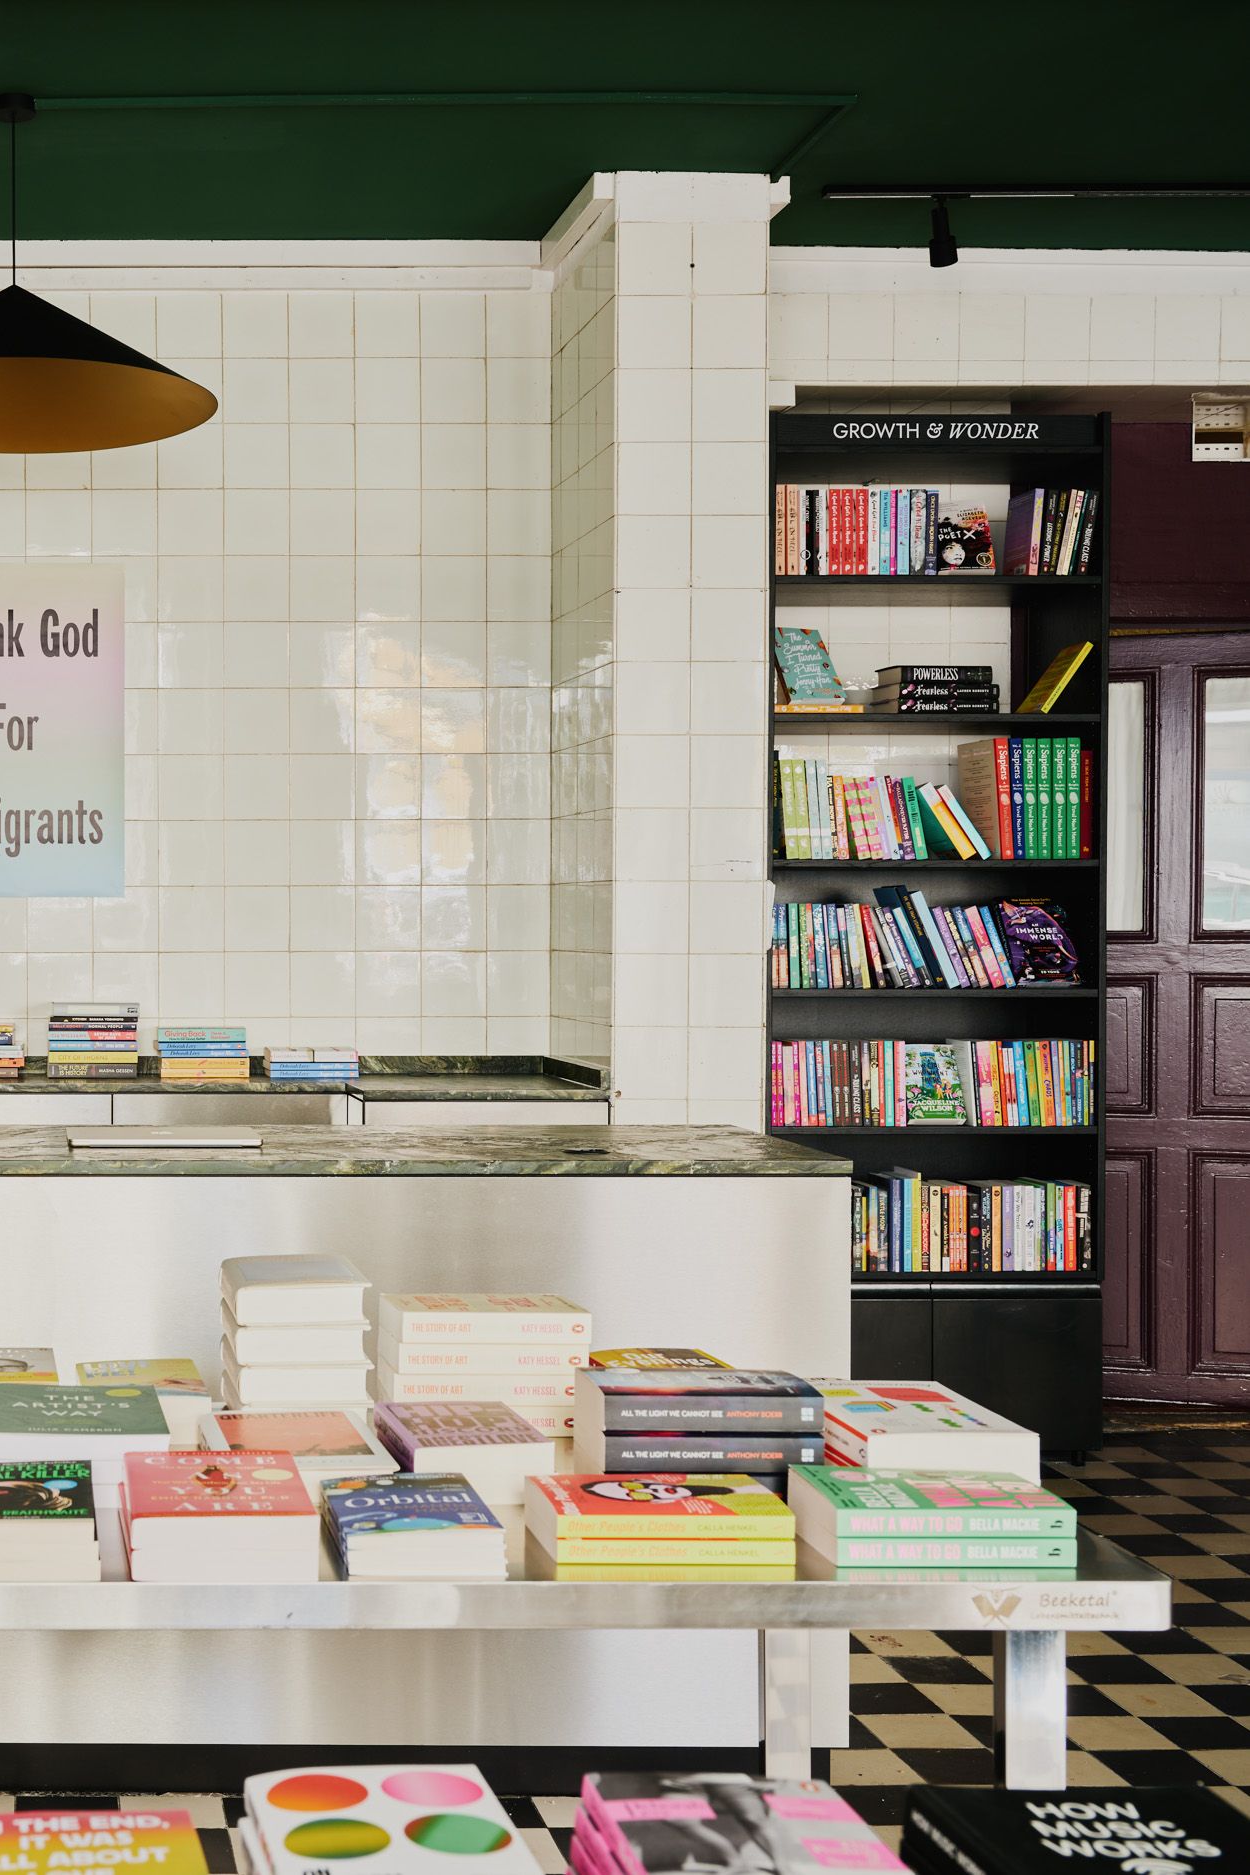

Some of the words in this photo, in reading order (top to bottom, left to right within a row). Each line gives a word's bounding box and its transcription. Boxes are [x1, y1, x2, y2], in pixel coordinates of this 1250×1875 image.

[833, 422, 920, 440] GROWTH
[926, 422, 944, 440] &
[949, 422, 1040, 440] WONDER
[938, 530, 962, 542] POET
[962, 530, 977, 541] X
[40, 608, 99, 658] God
[913, 667, 959, 681] POWERLESS
[915, 685, 949, 698] Fearless
[997, 749, 1008, 780] Sapiens
[1012, 749, 1022, 780] Sapiens
[1025, 749, 1035, 780] Sapiens
[1039, 749, 1049, 780] Sapiens
[1054, 749, 1065, 780] Sapiens
[1069, 749, 1079, 780] Sapiens
[164, 1030, 187, 1040] Giving
[187, 1030, 207, 1039] Back
[423, 1323, 447, 1333] STORY
[538, 1324, 563, 1333] HESSEL
[518, 1356, 535, 1365] KATY
[536, 1356, 561, 1365] HESSEL
[606, 1356, 716, 1367] Evenings
[622, 1352, 664, 1360] Our
[514, 1386, 531, 1396] KATY
[532, 1386, 558, 1396] HESSEL
[11, 1401, 131, 1409] ARTIST'S
[41, 1409, 103, 1417] WAY
[621, 1410, 634, 1418] ALL
[634, 1410, 648, 1418] THE
[648, 1410, 669, 1418] LIGHT
[143, 1455, 278, 1466] COME
[622, 1451, 635, 1459] ALL
[635, 1451, 648, 1459] THE
[648, 1451, 669, 1459] LIGHT
[681, 1451, 710, 1459] CANNOT
[711, 1451, 724, 1459] SEE
[726, 1452, 760, 1460] ANTHONY
[20, 1469, 91, 1480] KILLER
[173, 1501, 275, 1511] ARE
[344, 1492, 474, 1509] Orbital
[567, 1520, 599, 1533] Other
[598, 1520, 645, 1533] People's
[646, 1520, 686, 1533] Clothes
[697, 1524, 725, 1532] CALLA
[725, 1524, 758, 1532] HENKEL
[850, 1517, 886, 1532] WHAT
[887, 1517, 896, 1531] A
[899, 1517, 925, 1531] WAY
[926, 1517, 944, 1531] TO
[945, 1517, 963, 1531] GO
[969, 1518, 1000, 1531] BELLA
[1002, 1518, 1041, 1531] MACKIE
[848, 1544, 886, 1559] WHAT
[898, 1544, 924, 1559] WAY
[926, 1544, 942, 1558] TO
[944, 1544, 962, 1559] GO
[967, 1545, 998, 1559] BELLA
[1000, 1545, 1039, 1559] MACKIE
[1024, 1801, 1140, 1821] HOW
[12, 1816, 81, 1835] THE
[89, 1814, 171, 1832] END,
[1029, 1819, 1187, 1839] MUSIC
[18, 1833, 54, 1850] IT
[59, 1829, 134, 1848] WAS
[1040, 1838, 1223, 1859] WORKS
[47, 1846, 170, 1868] ABOUT
